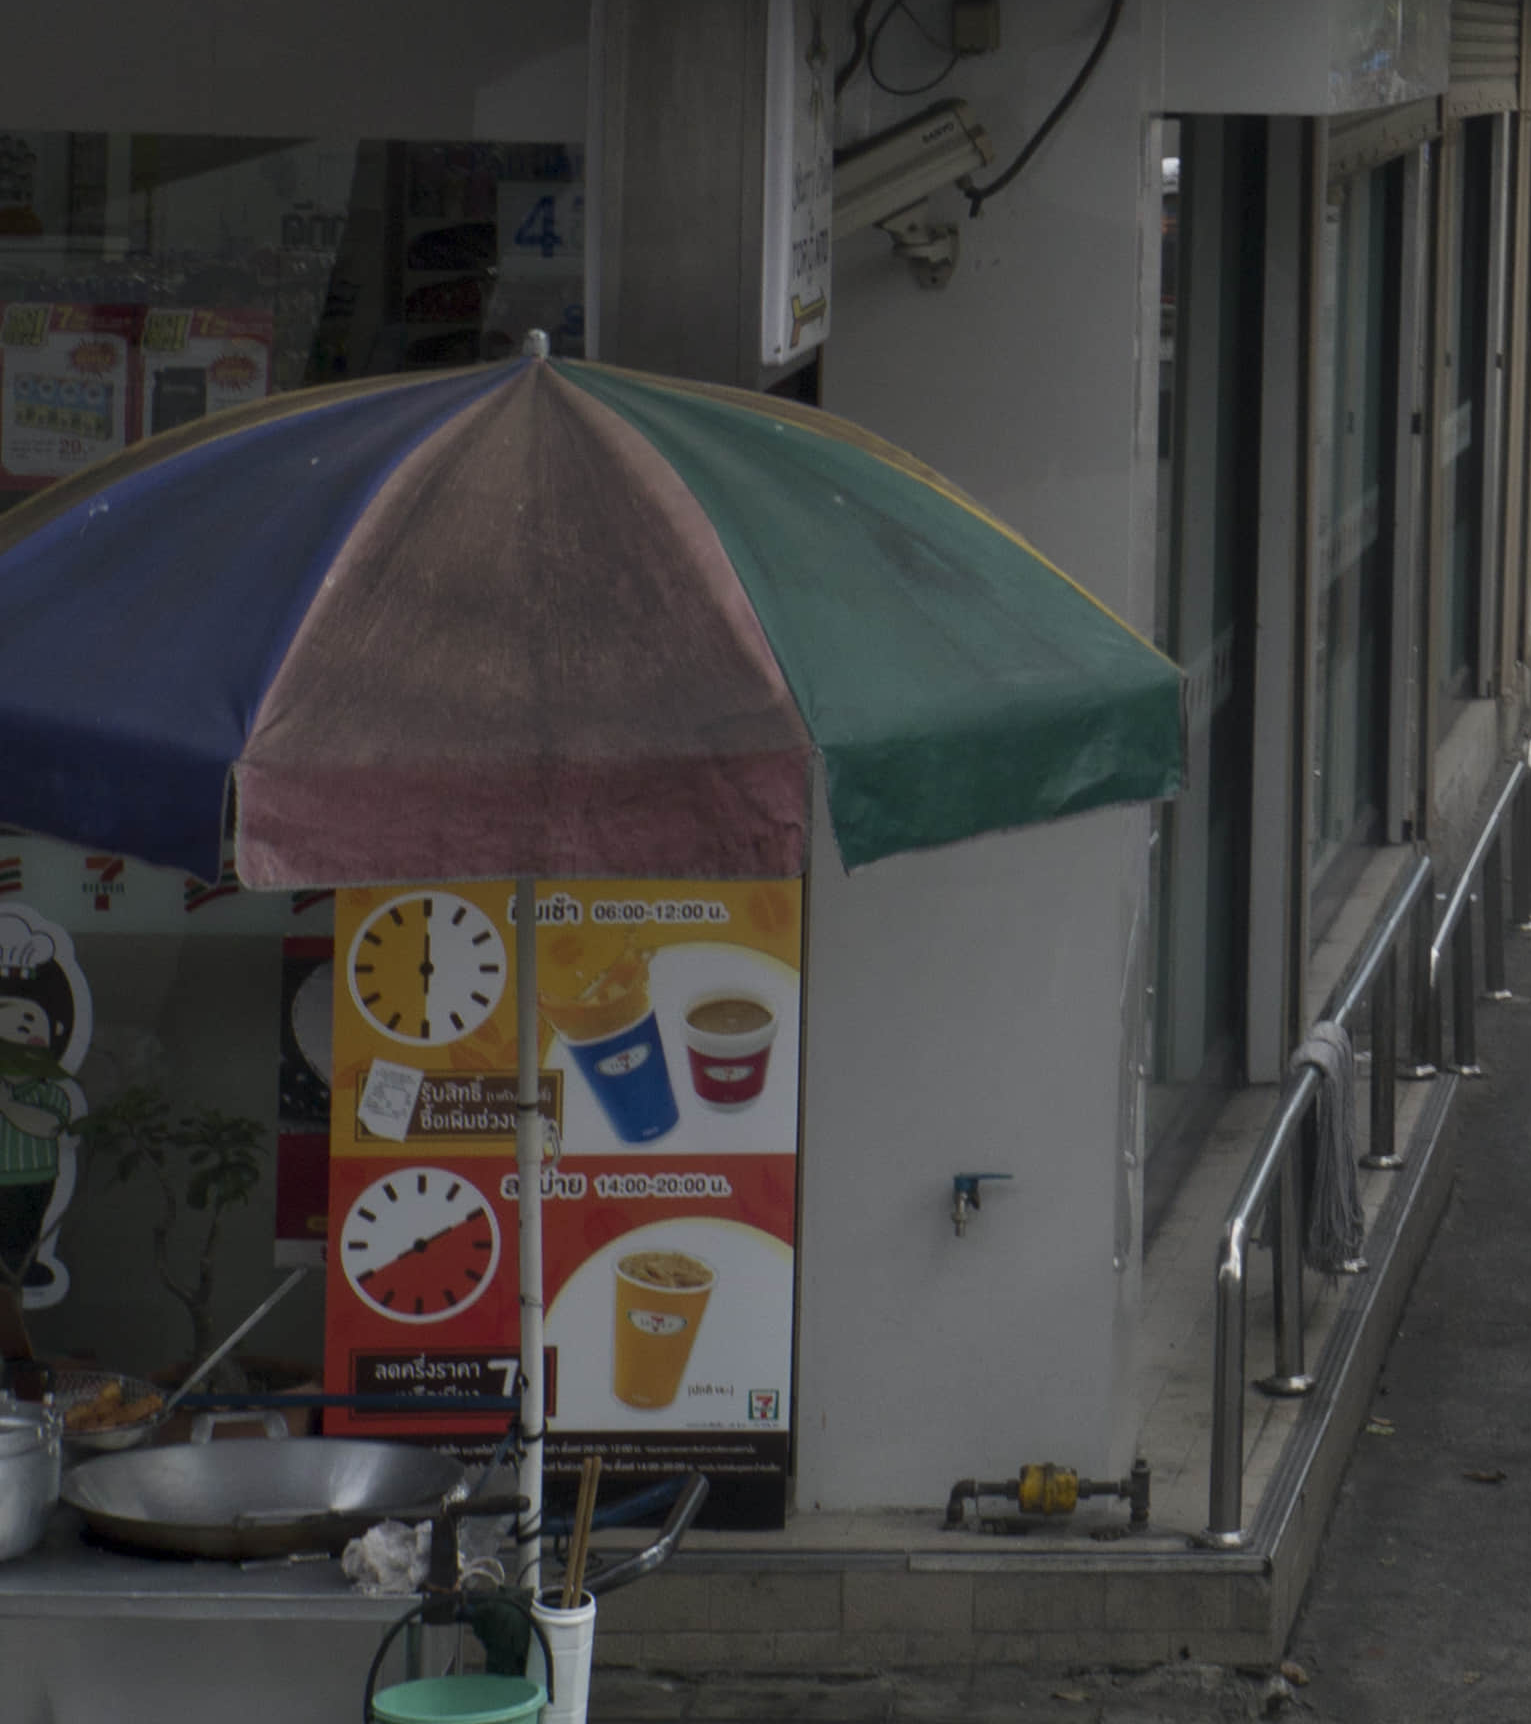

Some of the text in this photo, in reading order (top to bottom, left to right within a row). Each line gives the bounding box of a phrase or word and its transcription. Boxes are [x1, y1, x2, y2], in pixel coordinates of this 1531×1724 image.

[593, 903, 704, 921] 06:00-12:00
[596, 1178, 705, 1194] 14:00-20:00
[374, 1353, 481, 1381] ลดครึ่งราคา
